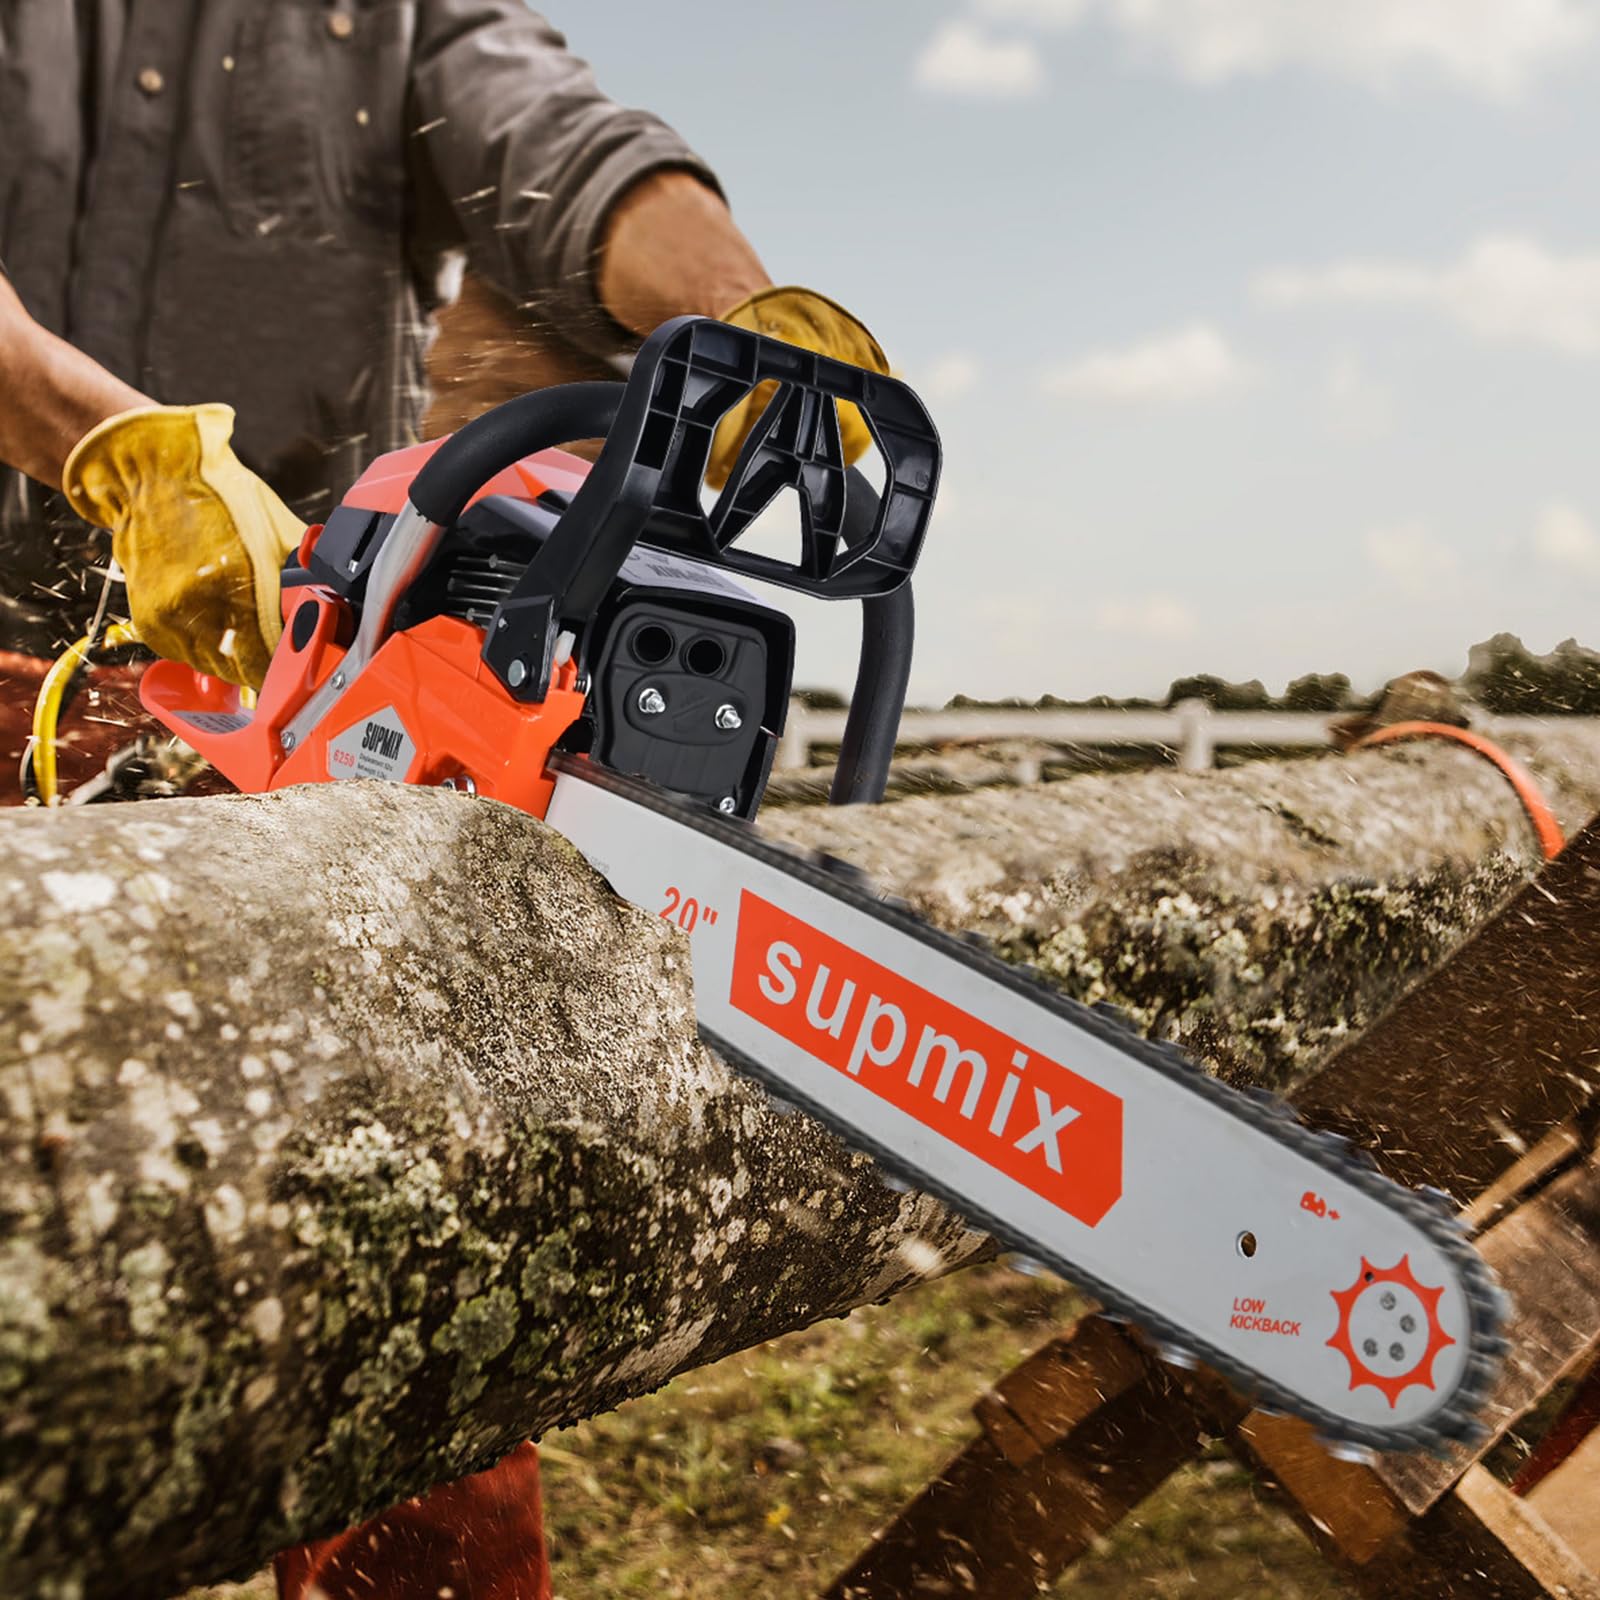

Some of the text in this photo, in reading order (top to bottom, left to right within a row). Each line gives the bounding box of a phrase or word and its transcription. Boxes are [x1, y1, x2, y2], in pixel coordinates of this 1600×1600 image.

[362, 721, 404, 761] SUPMIX
[758, 940, 1082, 1176] supmix
[1233, 1297, 1266, 1314] LOW
[1230, 1314, 1302, 1337] KICKBACK
